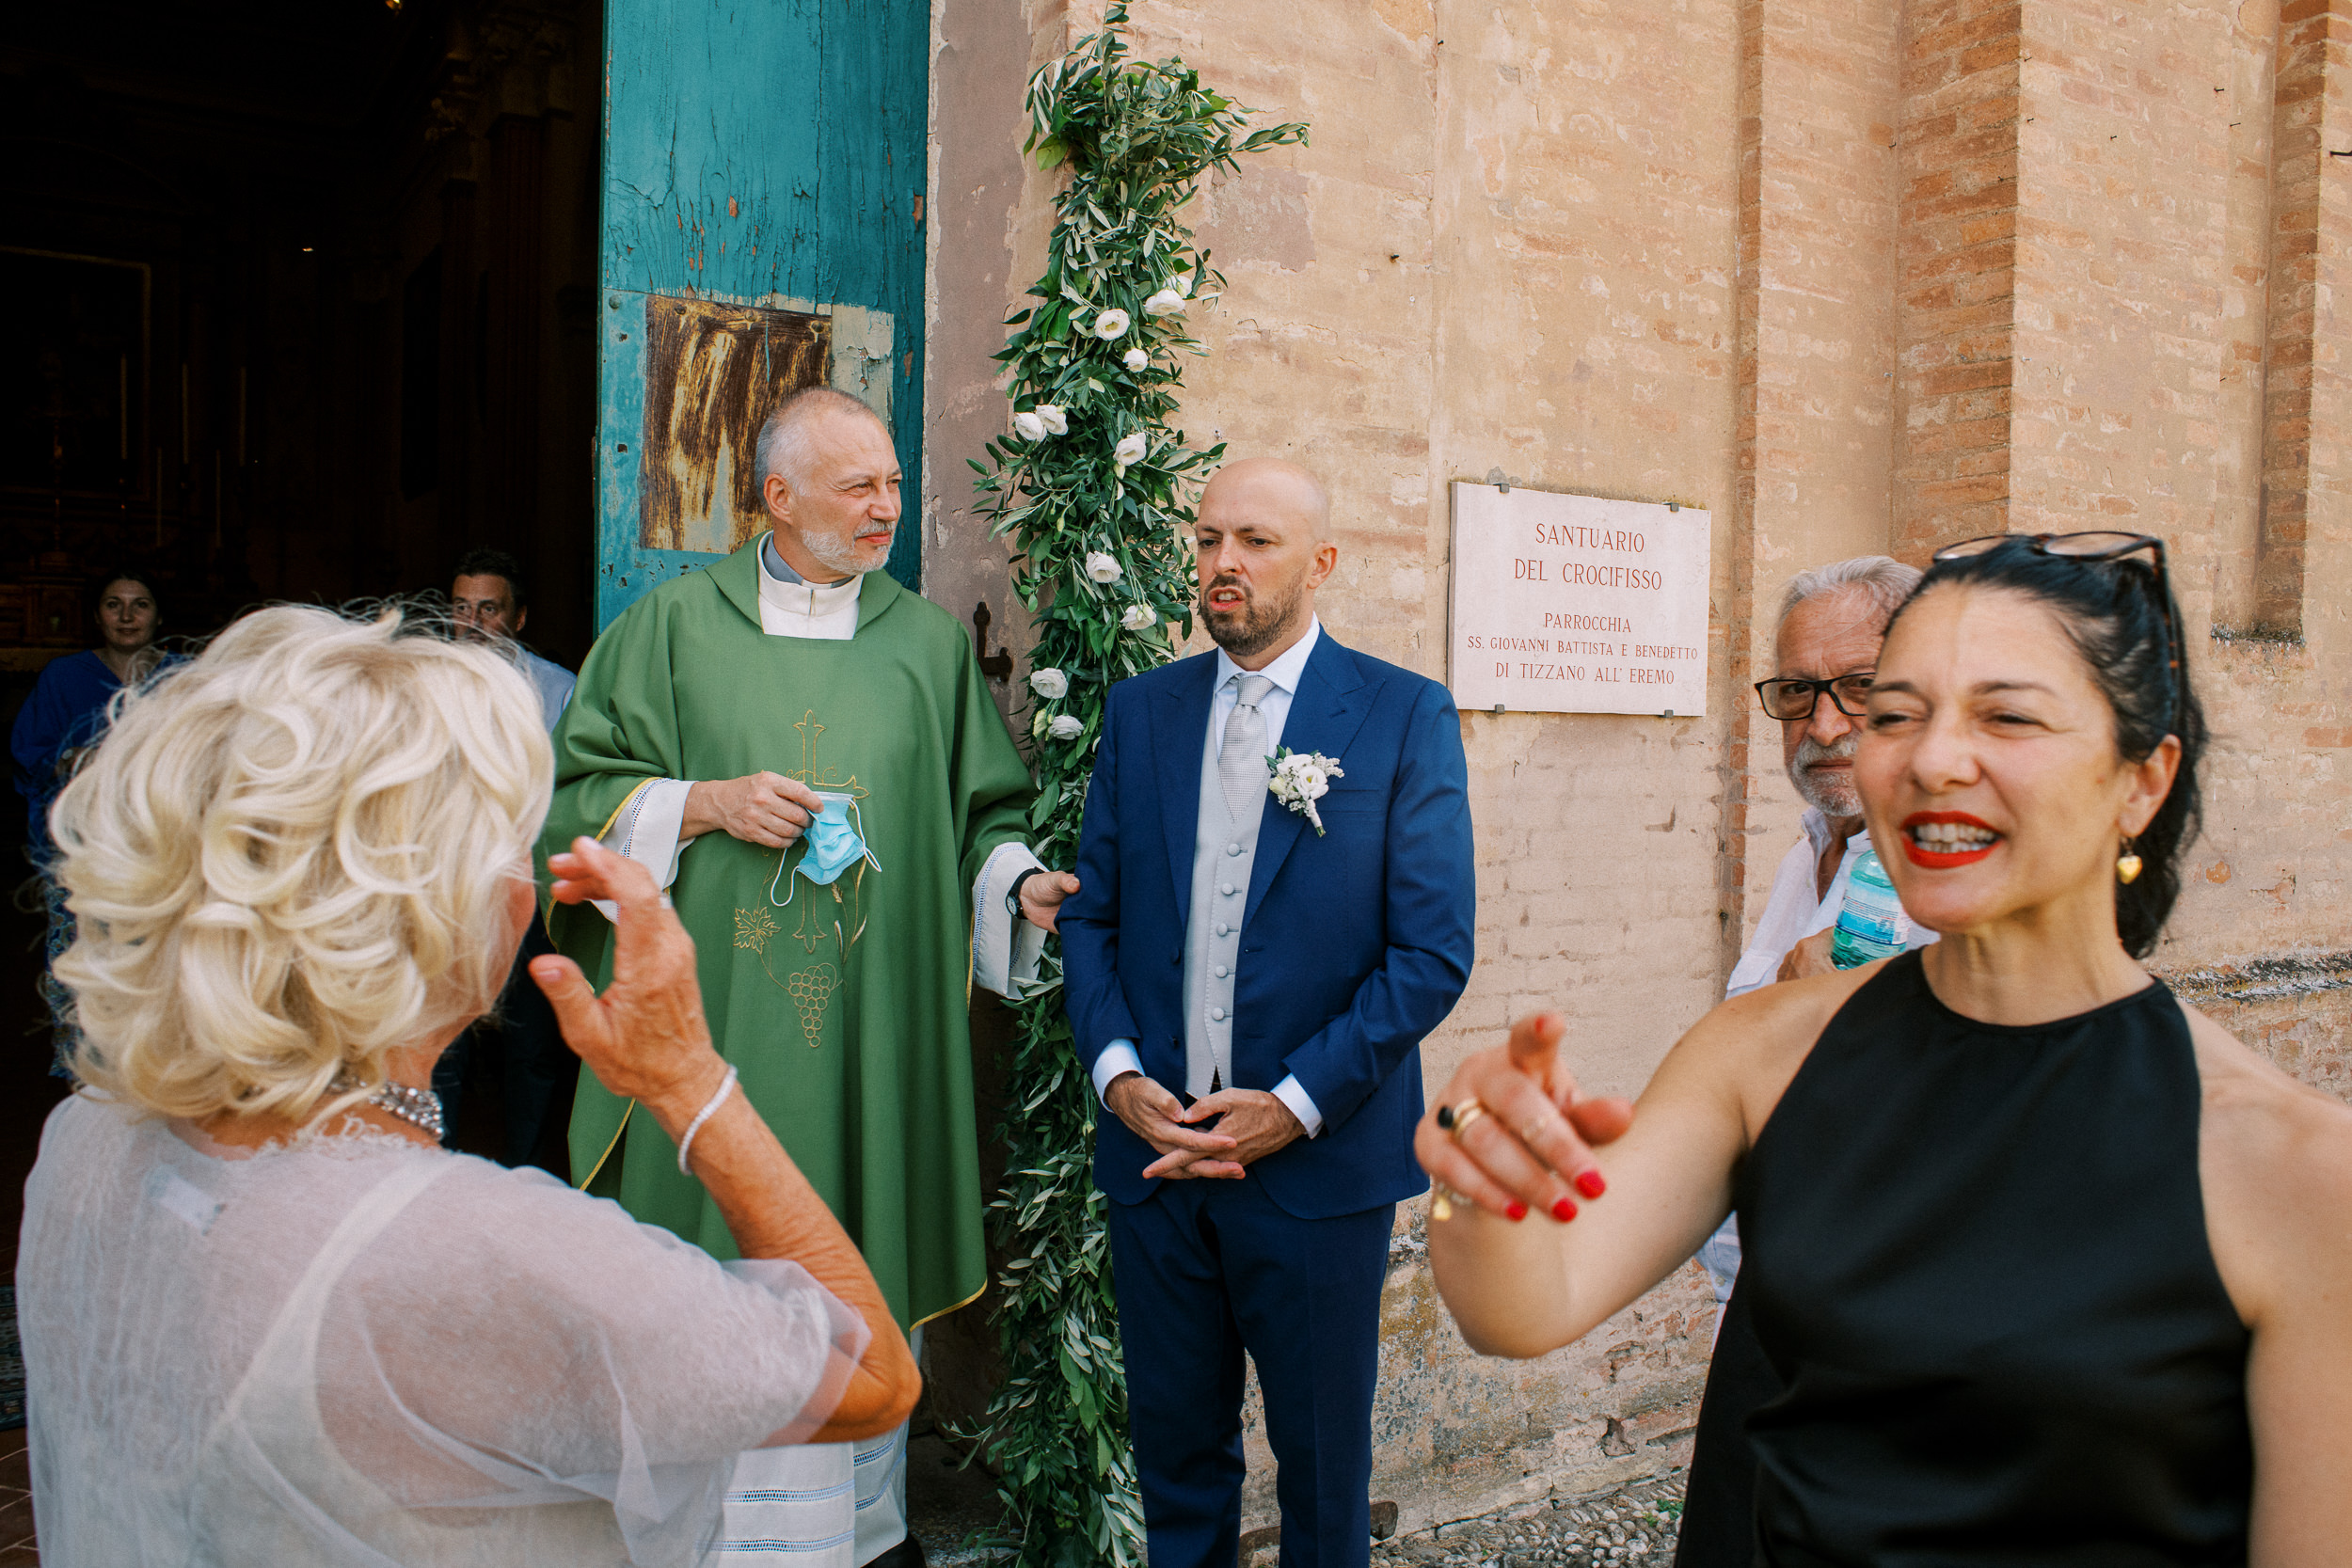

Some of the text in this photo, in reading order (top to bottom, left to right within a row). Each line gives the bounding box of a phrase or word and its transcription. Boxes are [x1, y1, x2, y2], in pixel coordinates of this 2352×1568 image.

[1535, 523, 1645, 552] SANTUARIO
[1514, 559, 1661, 591] DEL CROCIFISSO
[1544, 612, 1632, 632] PARROCCHIA
[1468, 634, 1697, 659] SS. GIOVANNI BATTISTA E BENEDETTO
[1496, 662, 1508, 677] DI
[1520, 662, 1585, 681] TIZZANO
[1629, 669, 1675, 685] EREMO
